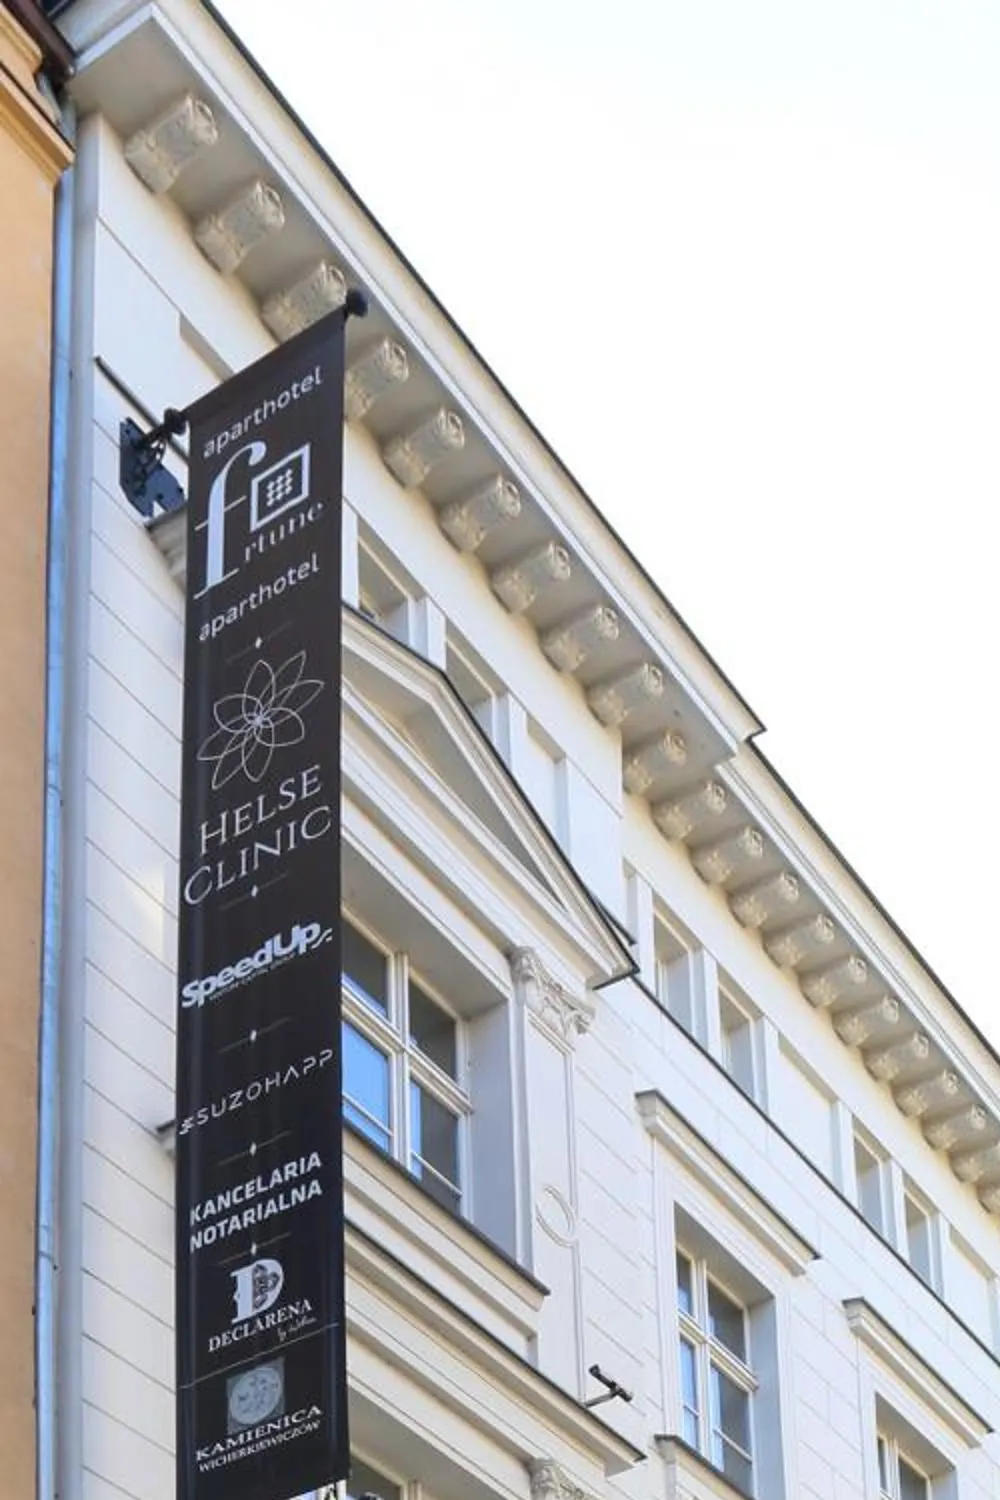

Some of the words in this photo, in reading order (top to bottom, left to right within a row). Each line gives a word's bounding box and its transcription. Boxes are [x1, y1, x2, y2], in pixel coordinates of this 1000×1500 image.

[203, 365, 323, 459] aparthotel
[199, 552, 320, 641] aparthotel
[201, 764, 322, 855] HELSE
[184, 805, 332, 905] CLINIC
[181, 922, 322, 1008] SpeedUp
[196, 1048, 334, 1126] SUZOHAPP
[189, 1179, 323, 1254] NOTARIALNA
[190, 1151, 323, 1227] KANCELARIA
[207, 1299, 313, 1353] DECLARENA
[195, 1405, 323, 1462] KAMIENICA
